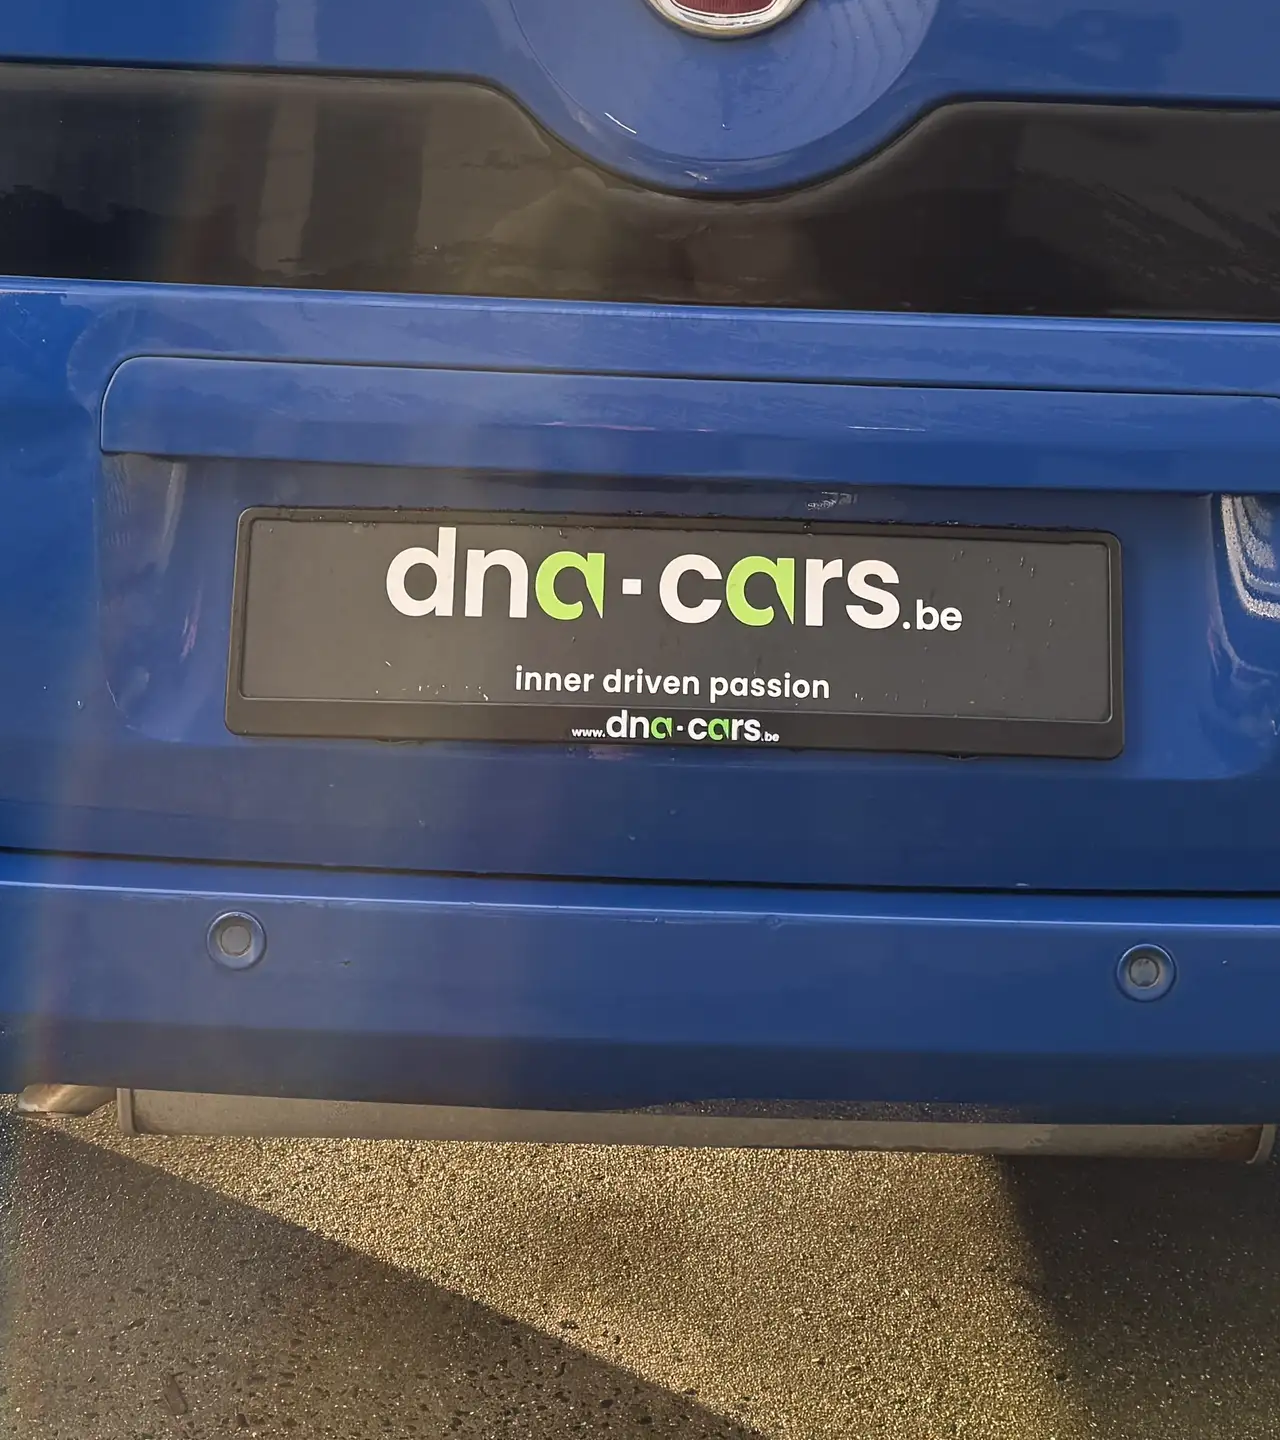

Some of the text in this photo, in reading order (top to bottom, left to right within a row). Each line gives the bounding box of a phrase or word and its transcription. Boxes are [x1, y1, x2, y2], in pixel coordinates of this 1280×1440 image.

[515, 664, 830, 704] inner driven passion
